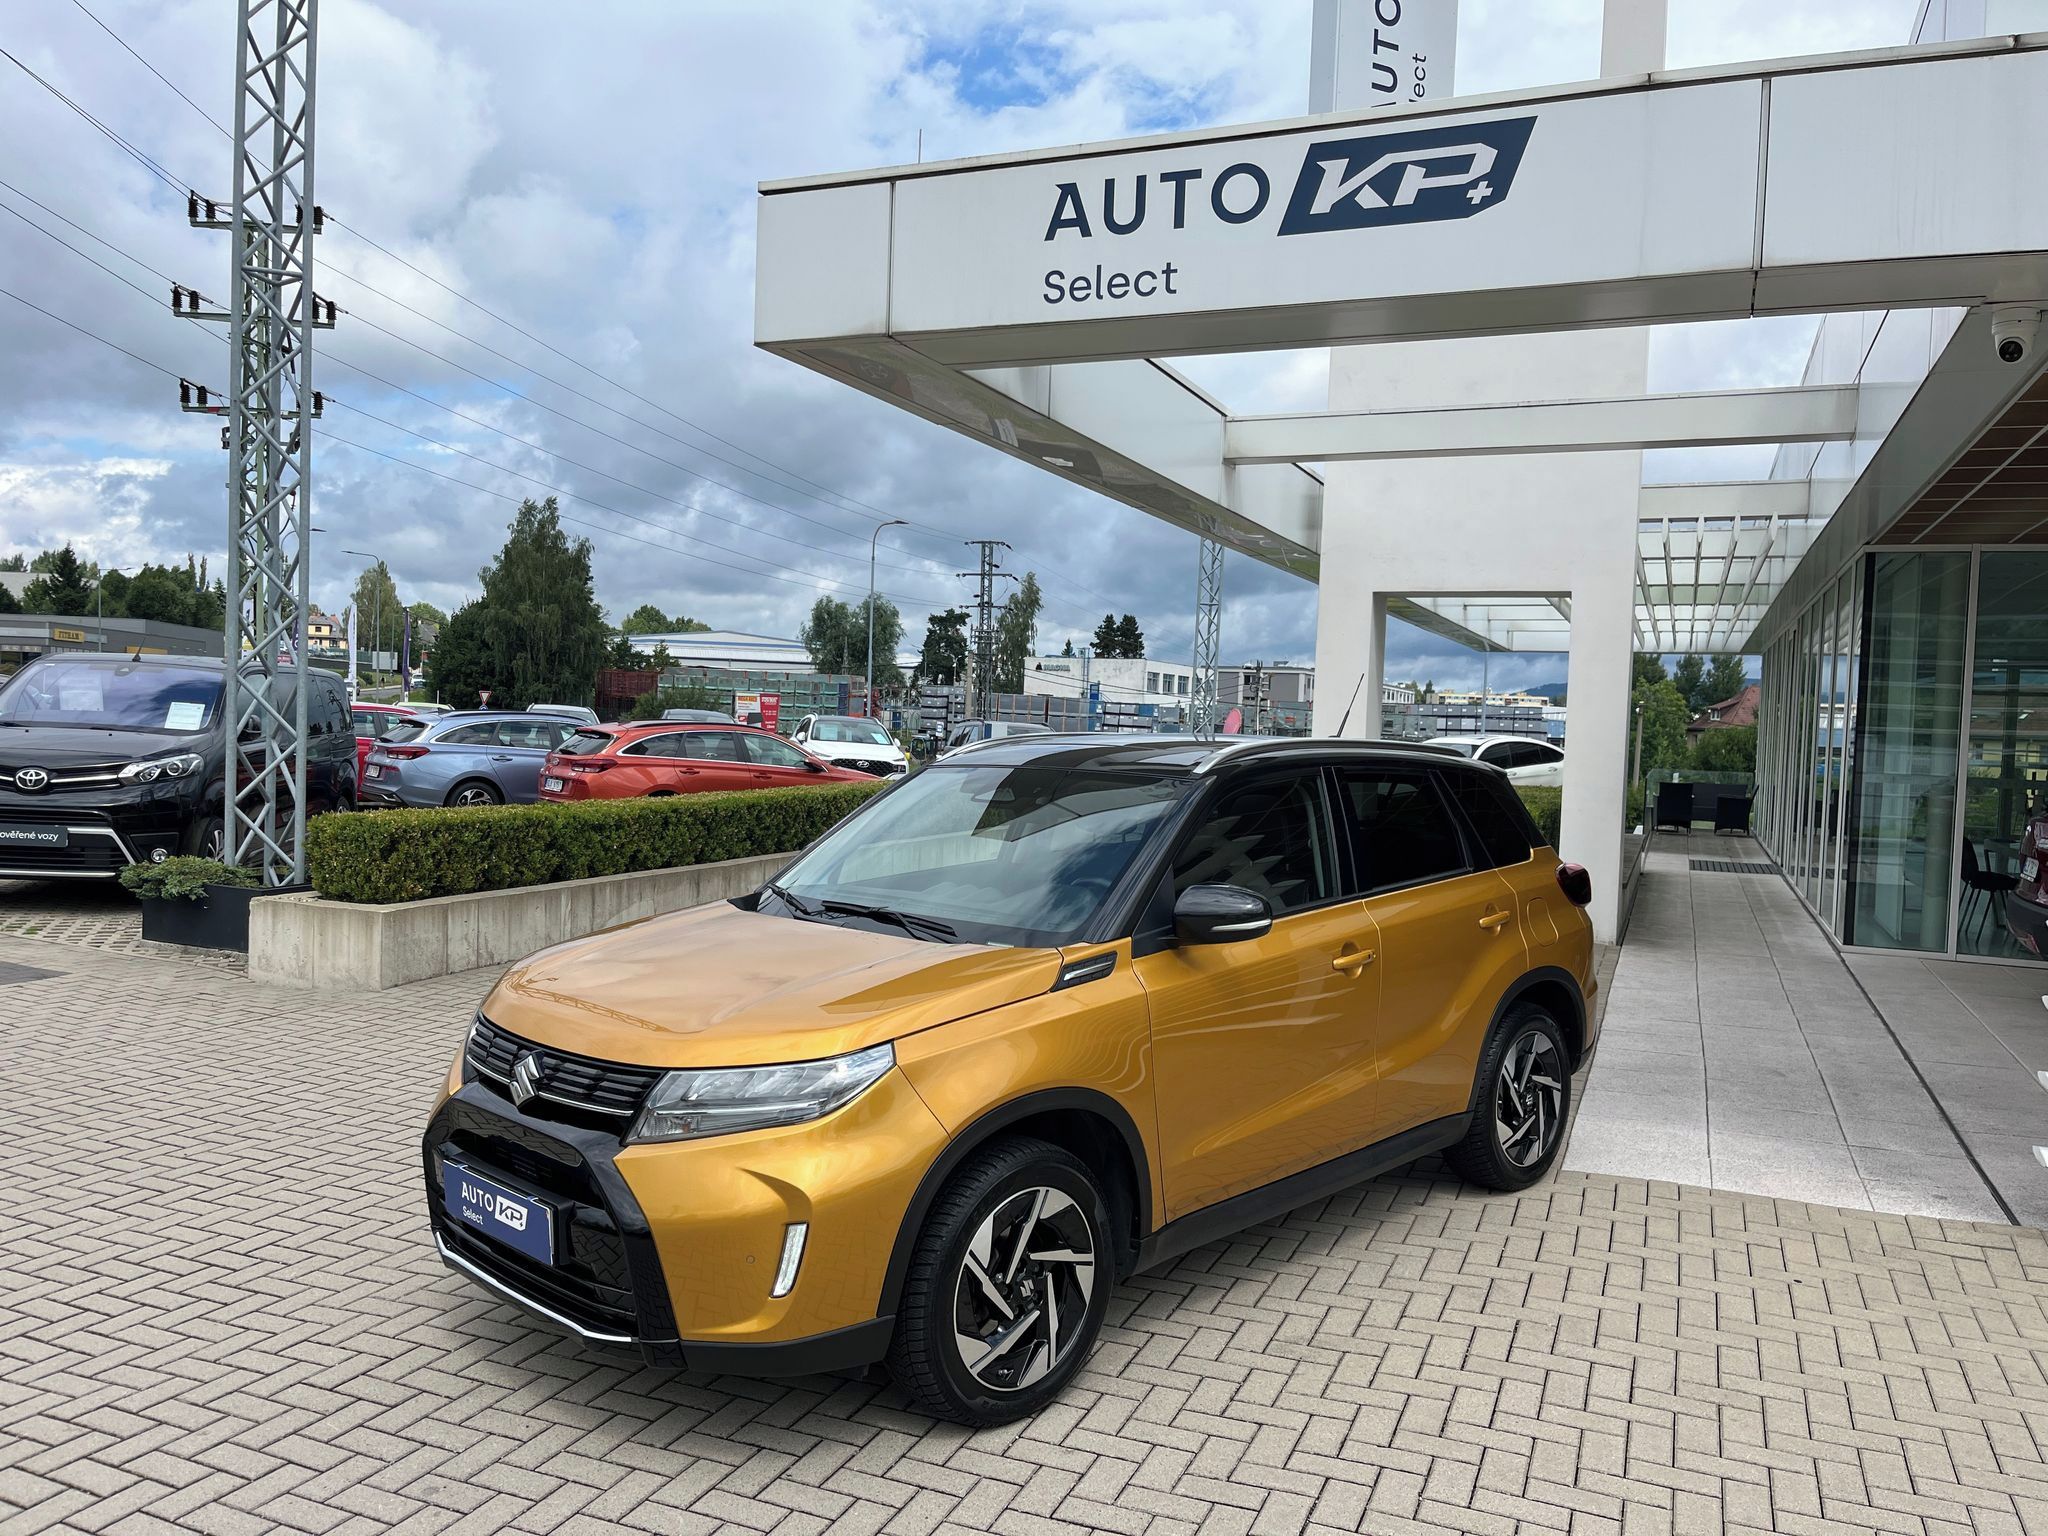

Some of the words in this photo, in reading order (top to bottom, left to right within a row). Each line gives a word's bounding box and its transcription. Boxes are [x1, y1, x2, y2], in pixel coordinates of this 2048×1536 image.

[1371, 0, 1402, 108] UTO
[1044, 162, 1271, 242] AUTO
[1043, 261, 1179, 305] Select
[37, 833, 59, 842] vozy
[461, 1181, 494, 1212] AUTO
[462, 1205, 484, 1225] Select
